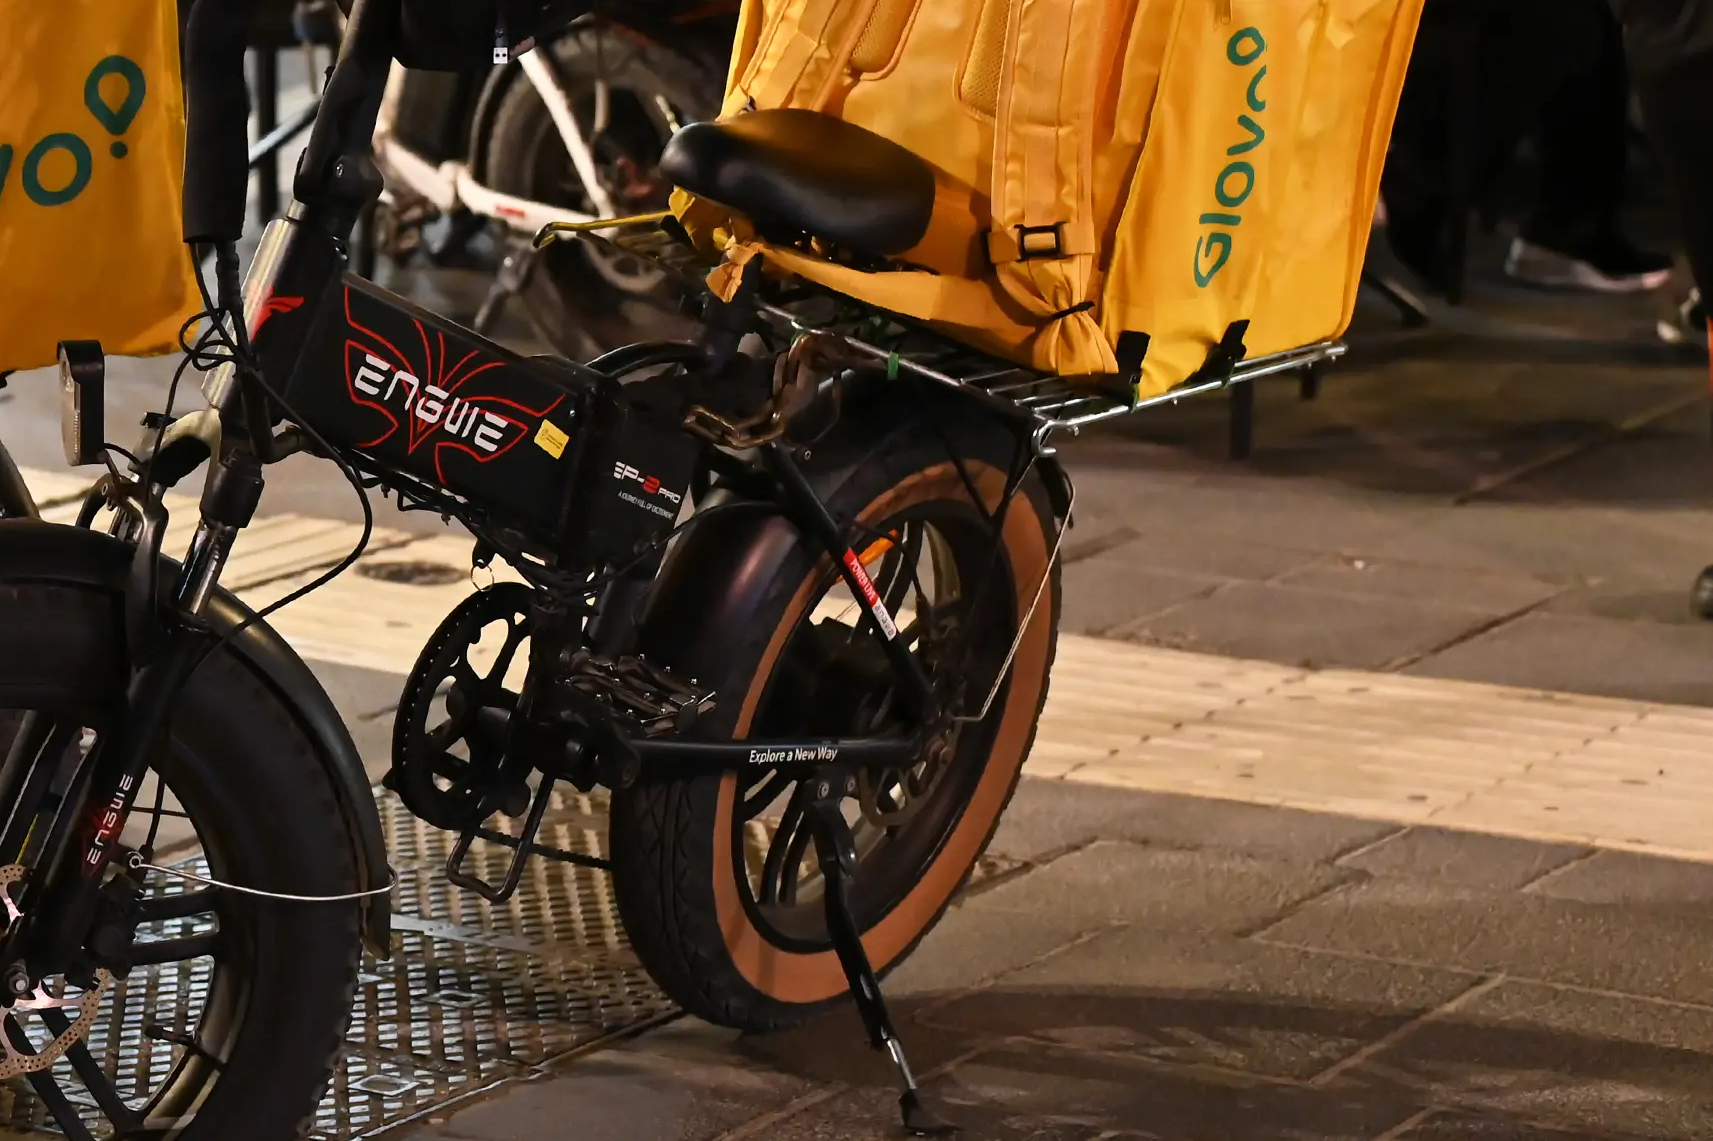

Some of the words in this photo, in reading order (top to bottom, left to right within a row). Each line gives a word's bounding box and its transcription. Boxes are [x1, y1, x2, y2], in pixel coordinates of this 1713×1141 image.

[1194, 64, 1266, 288] Glovo
[658, 487, 681, 504] PRO
[749, 748, 786, 765] Explore
[787, 751, 793, 762] a
[794, 748, 817, 761] New
[817, 746, 838, 762] Way
